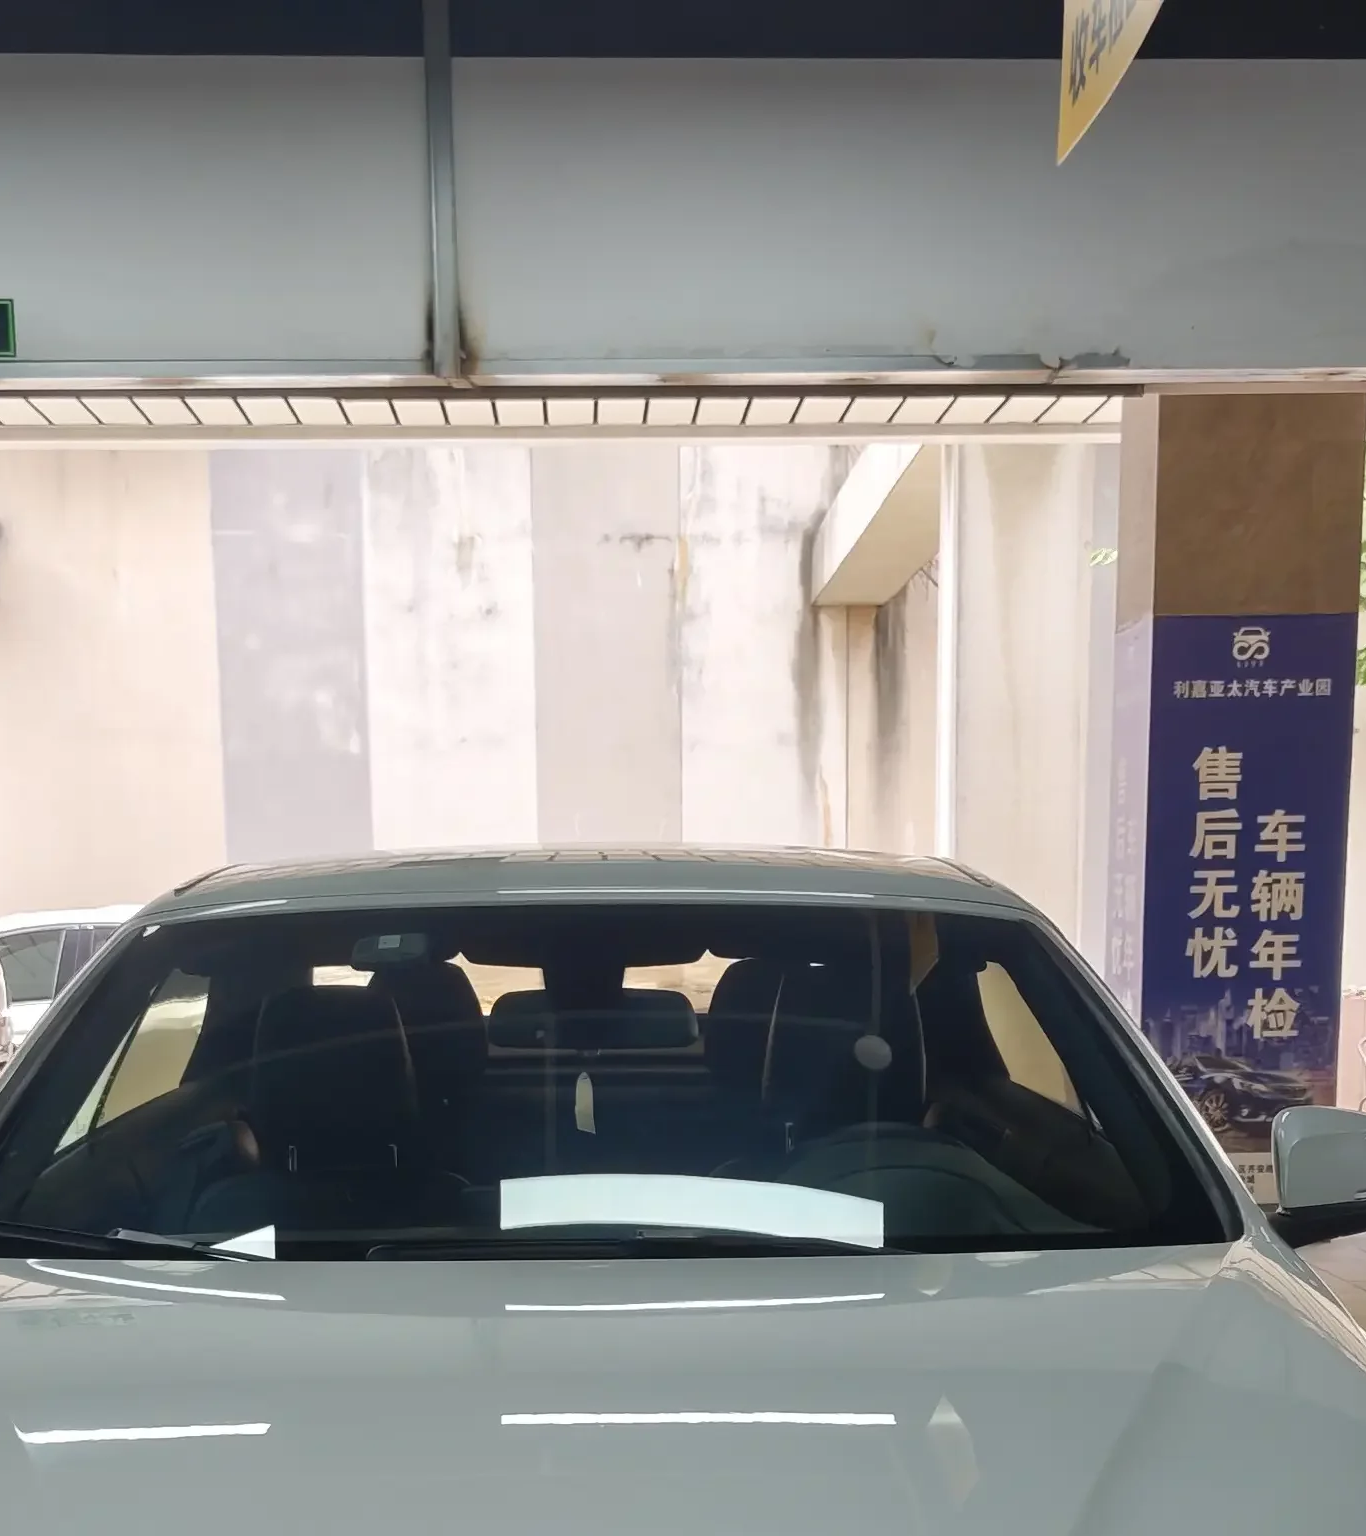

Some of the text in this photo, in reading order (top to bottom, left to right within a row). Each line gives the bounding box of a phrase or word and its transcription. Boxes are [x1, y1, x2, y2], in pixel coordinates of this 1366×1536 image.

[1185, 746, 1243, 979] 售后无忧
[1247, 810, 1306, 1040] 车辆年检
